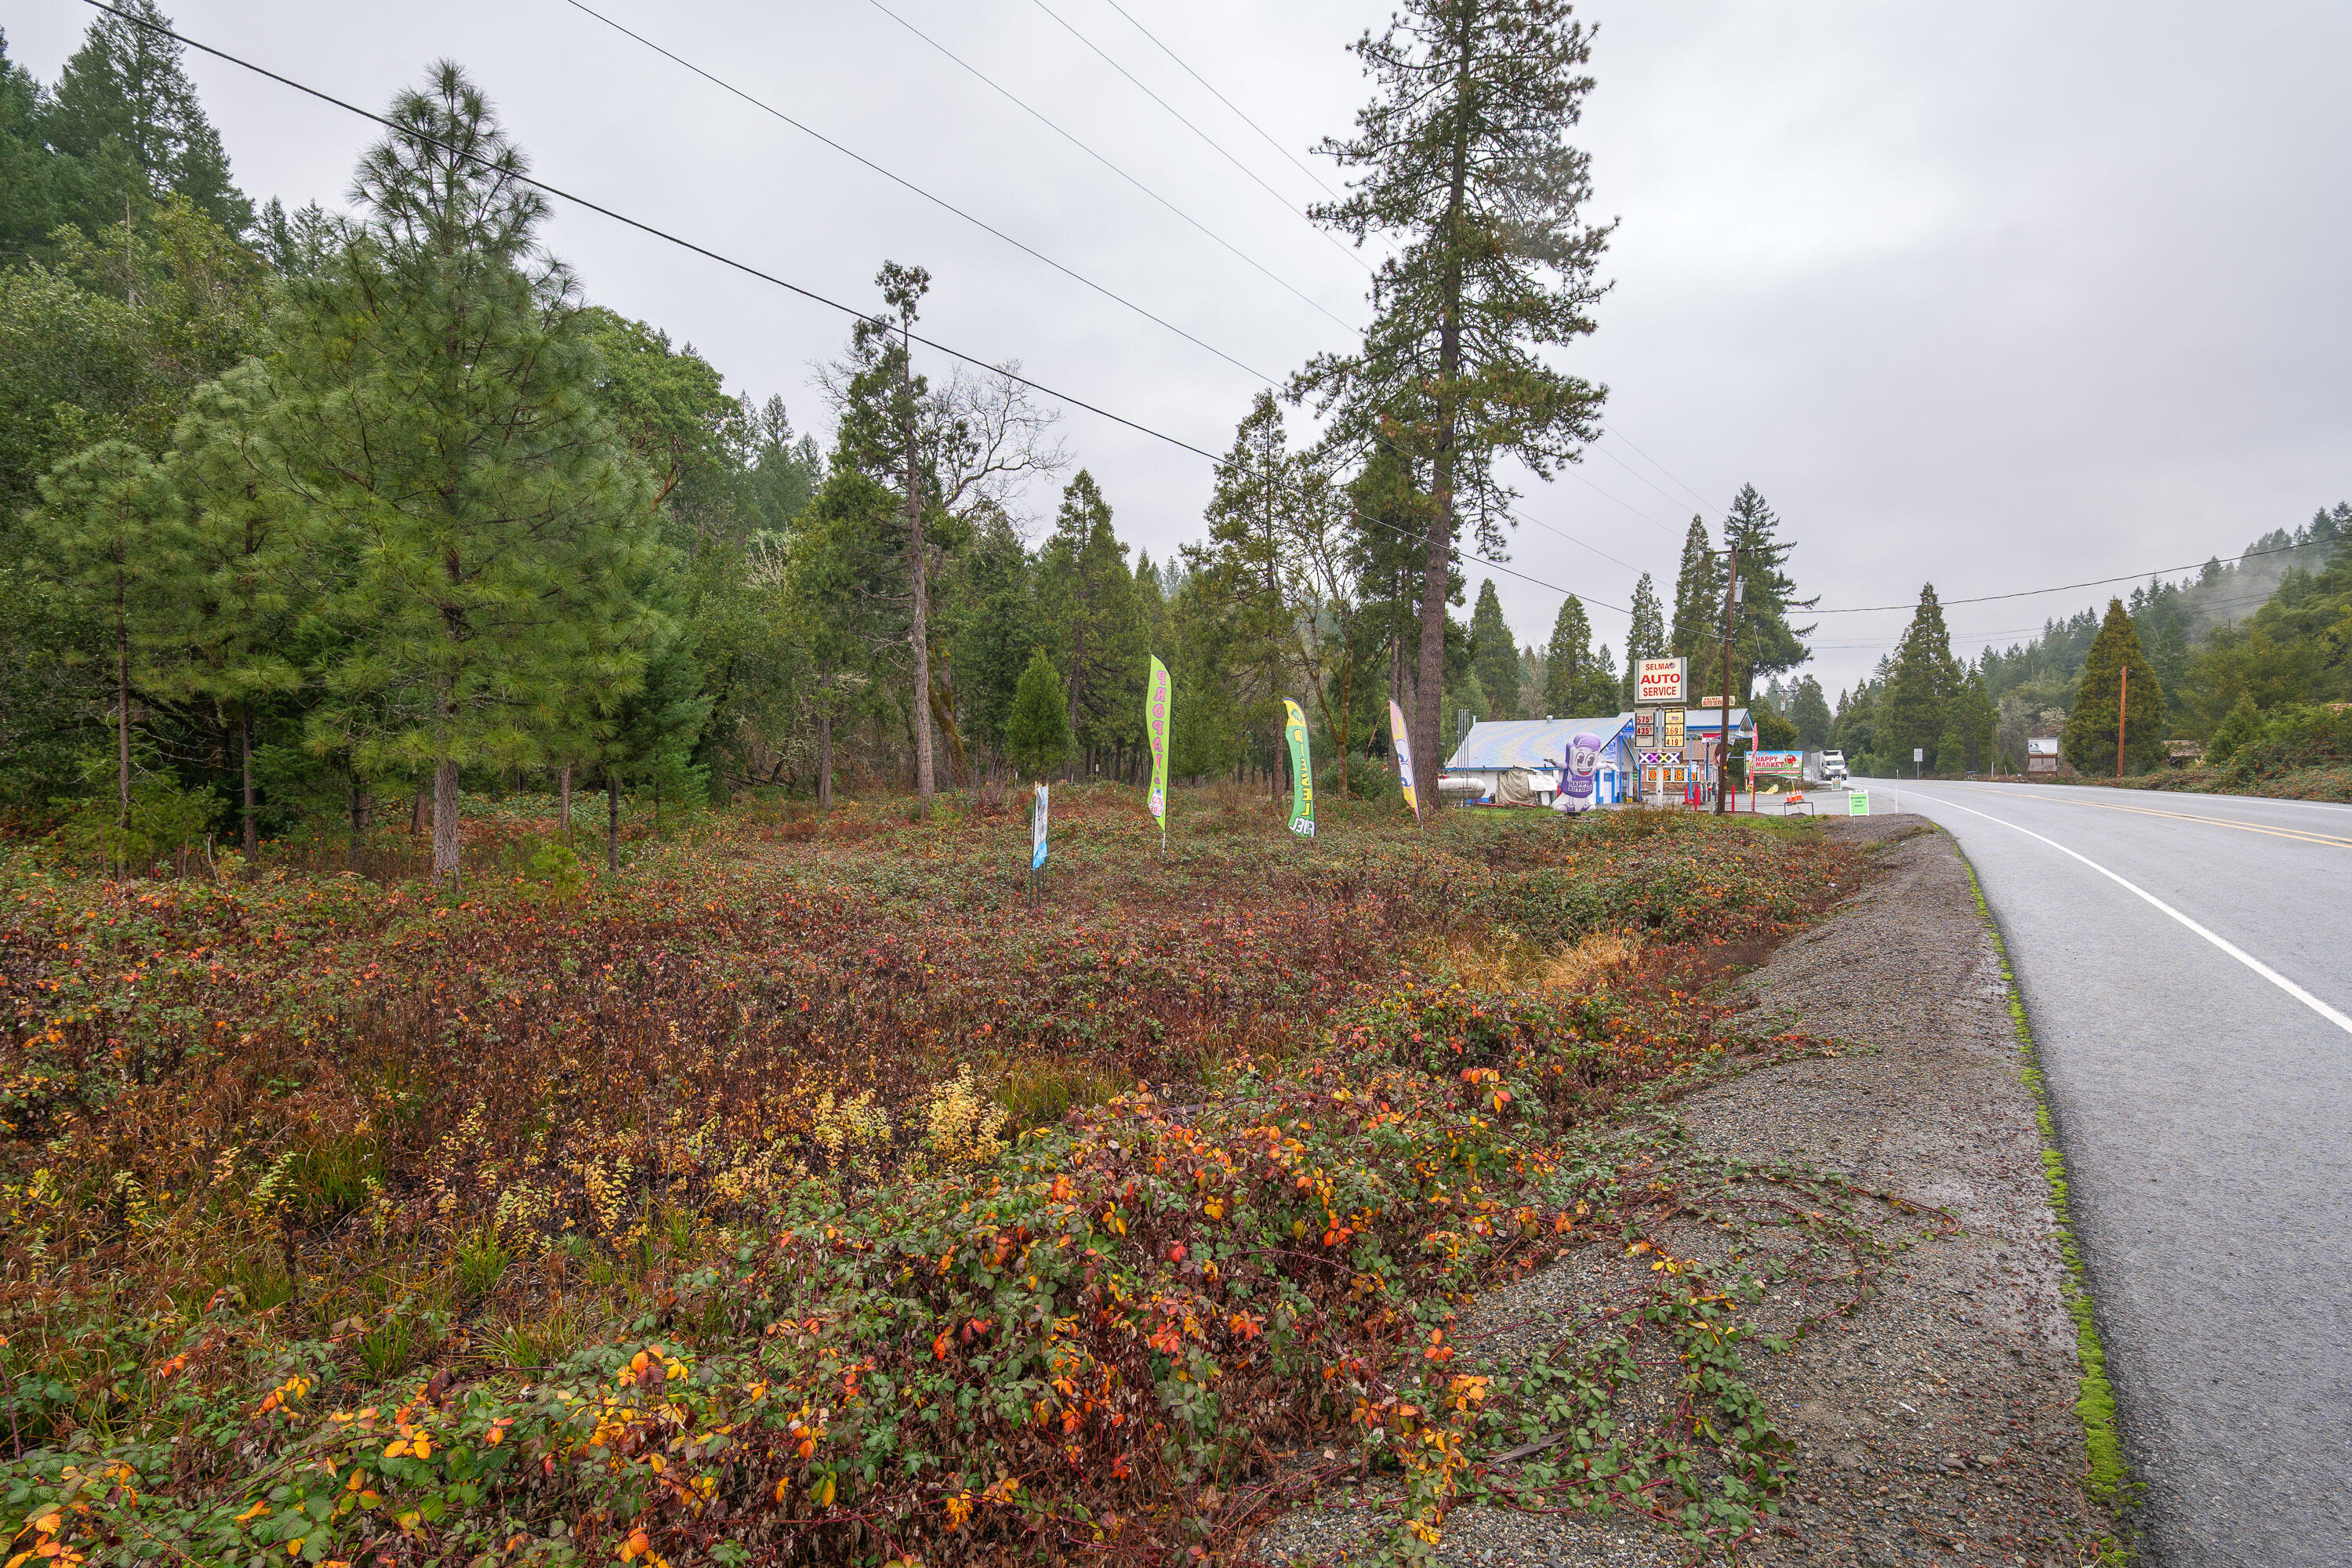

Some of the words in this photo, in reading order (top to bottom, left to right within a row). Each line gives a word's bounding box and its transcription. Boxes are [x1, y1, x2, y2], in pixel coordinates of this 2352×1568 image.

[1640, 673, 1680, 684] AUTO
[1643, 686, 1676, 697] SERVICE
[1649, 769, 1697, 781] OPEN
